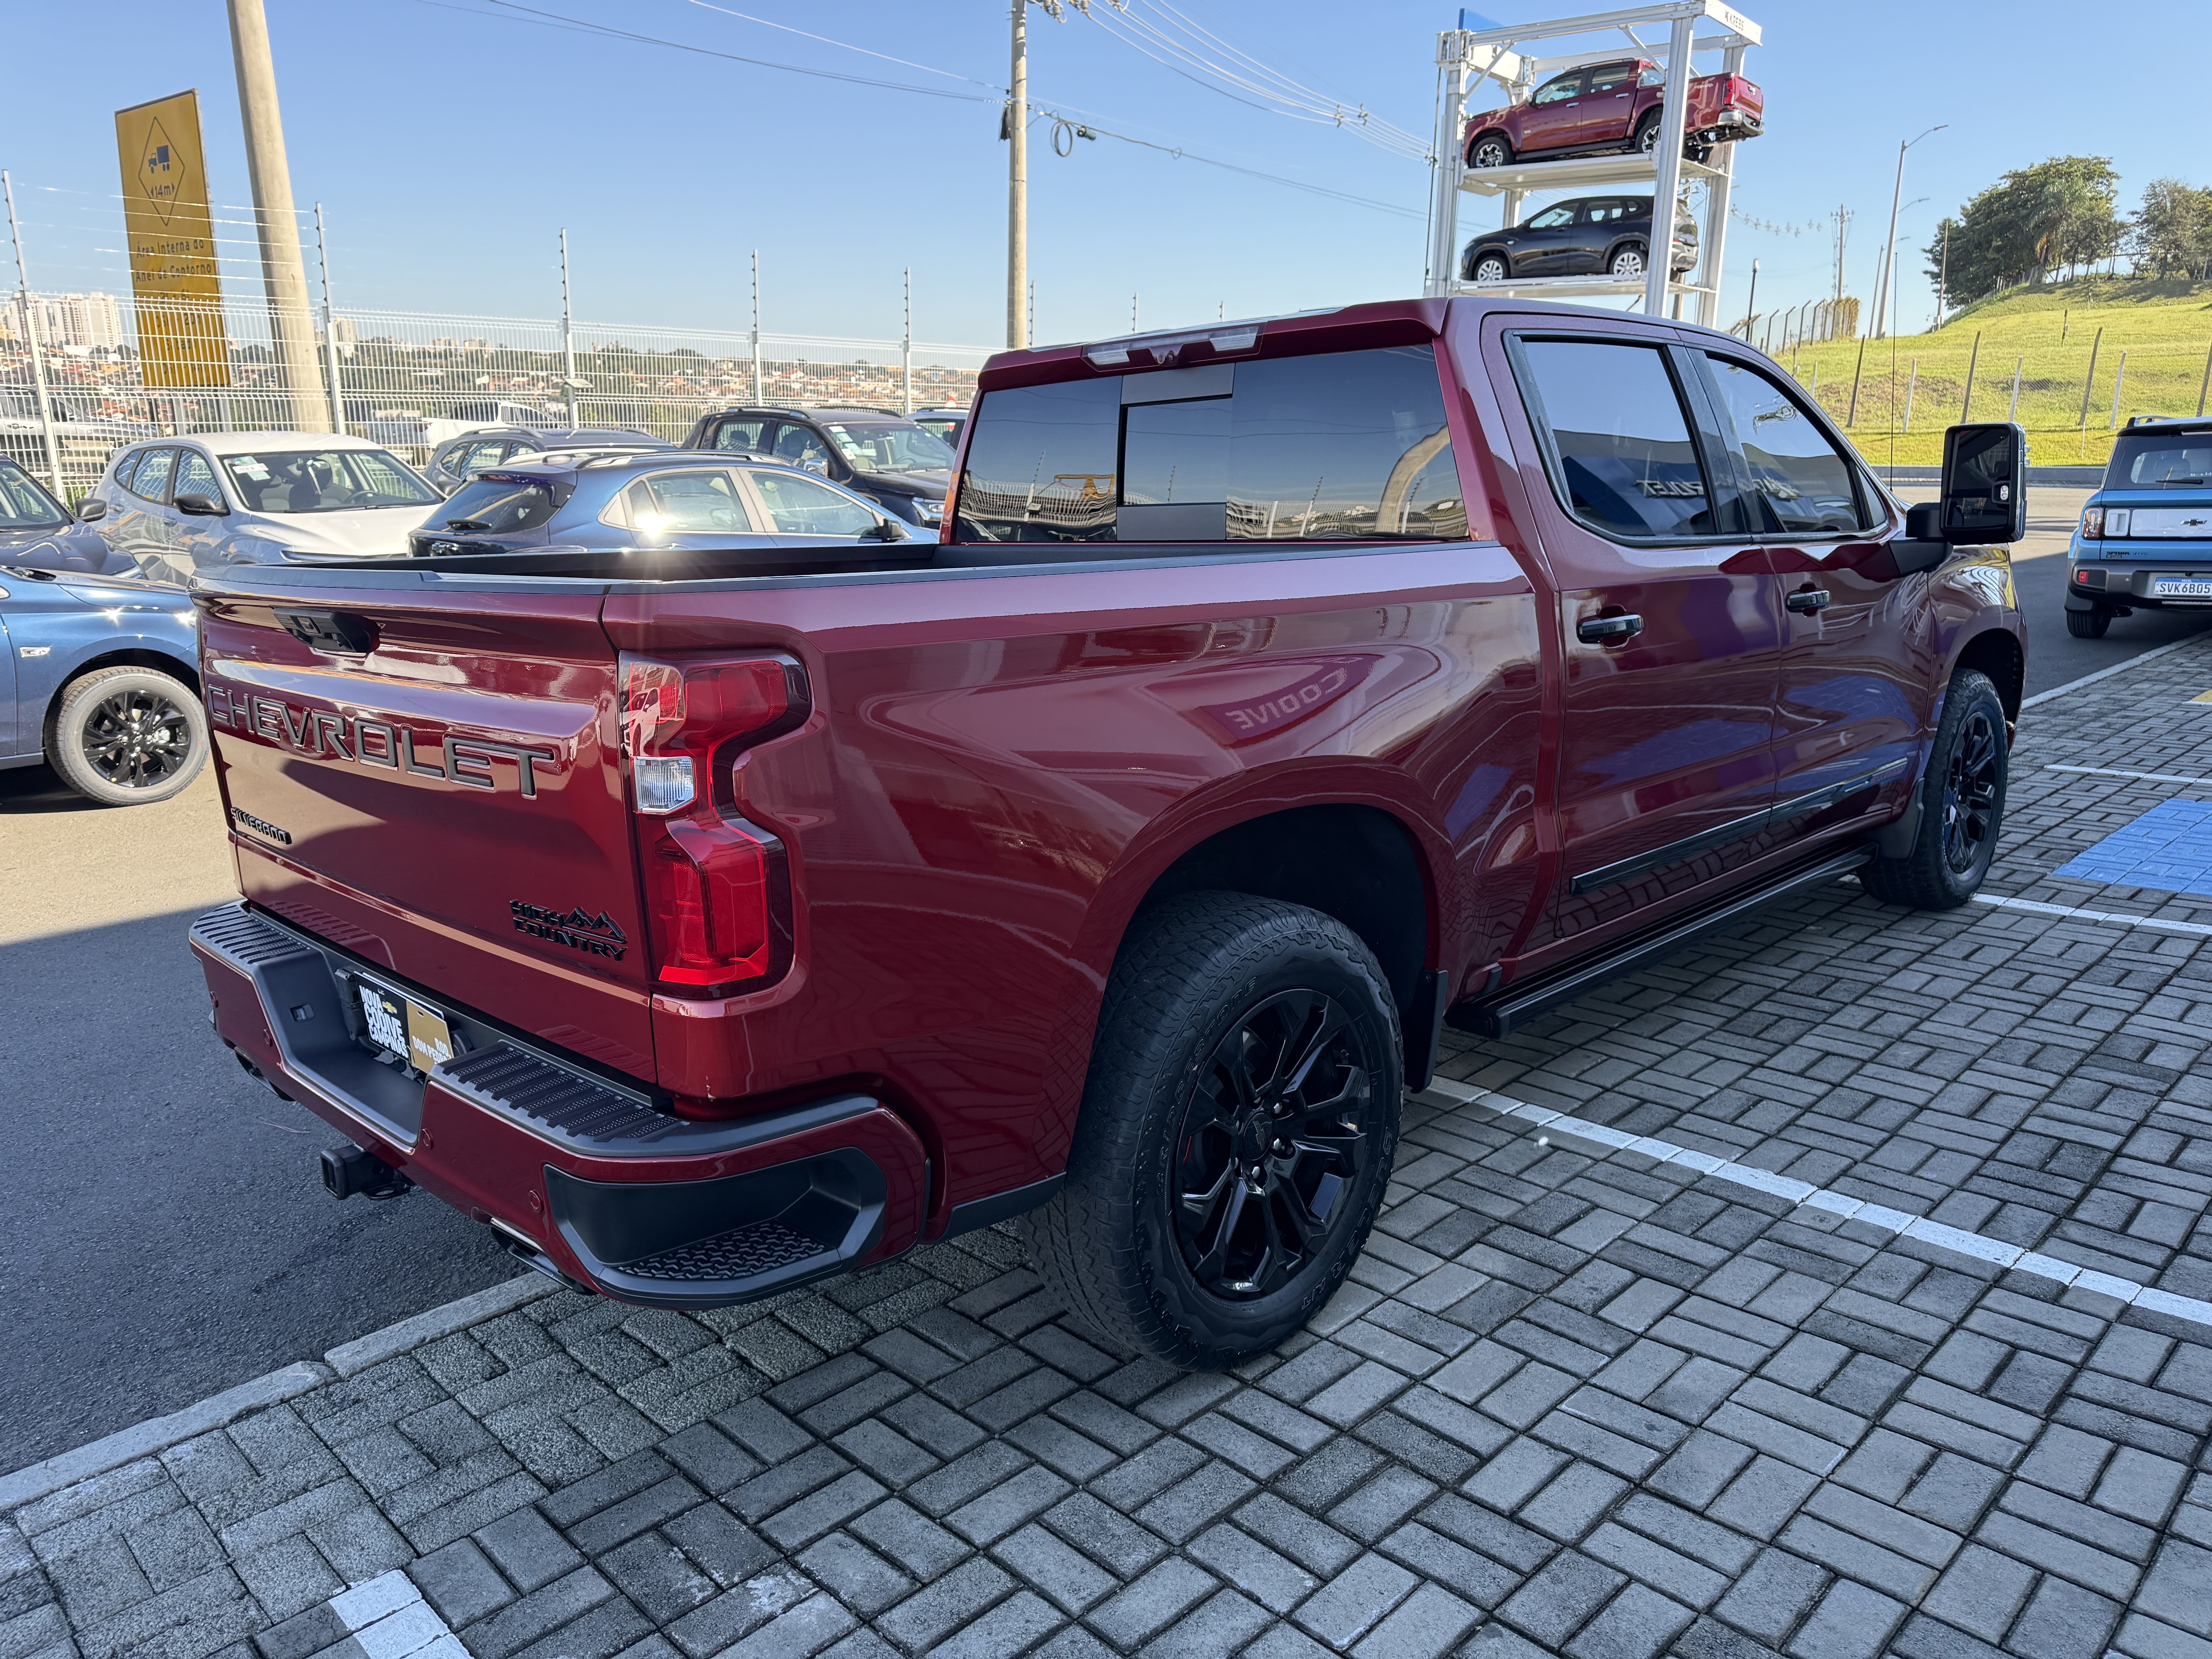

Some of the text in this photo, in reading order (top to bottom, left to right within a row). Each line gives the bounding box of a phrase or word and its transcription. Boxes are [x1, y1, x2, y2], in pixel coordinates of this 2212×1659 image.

[137, 239, 204, 258] Área Interna do
[136, 263, 211, 282] Anel de Contorno
[2160, 583, 2211, 593] SVK6B05
[208, 684, 555, 799] CHEVROLET
[231, 807, 292, 845] SILVERADO
[510, 899, 565, 927] HIGH
[513, 917, 628, 961] COUNTRY
[359, 985, 384, 1012] NOVA
[364, 1003, 405, 1043] CODIVE
[368, 1024, 409, 1058] CAMPINAS
[412, 1035, 428, 1056] DOM
[1156, 976, 1256, 1196] BRIDGESTONE
[1302, 1277, 1326, 1310] A/T
